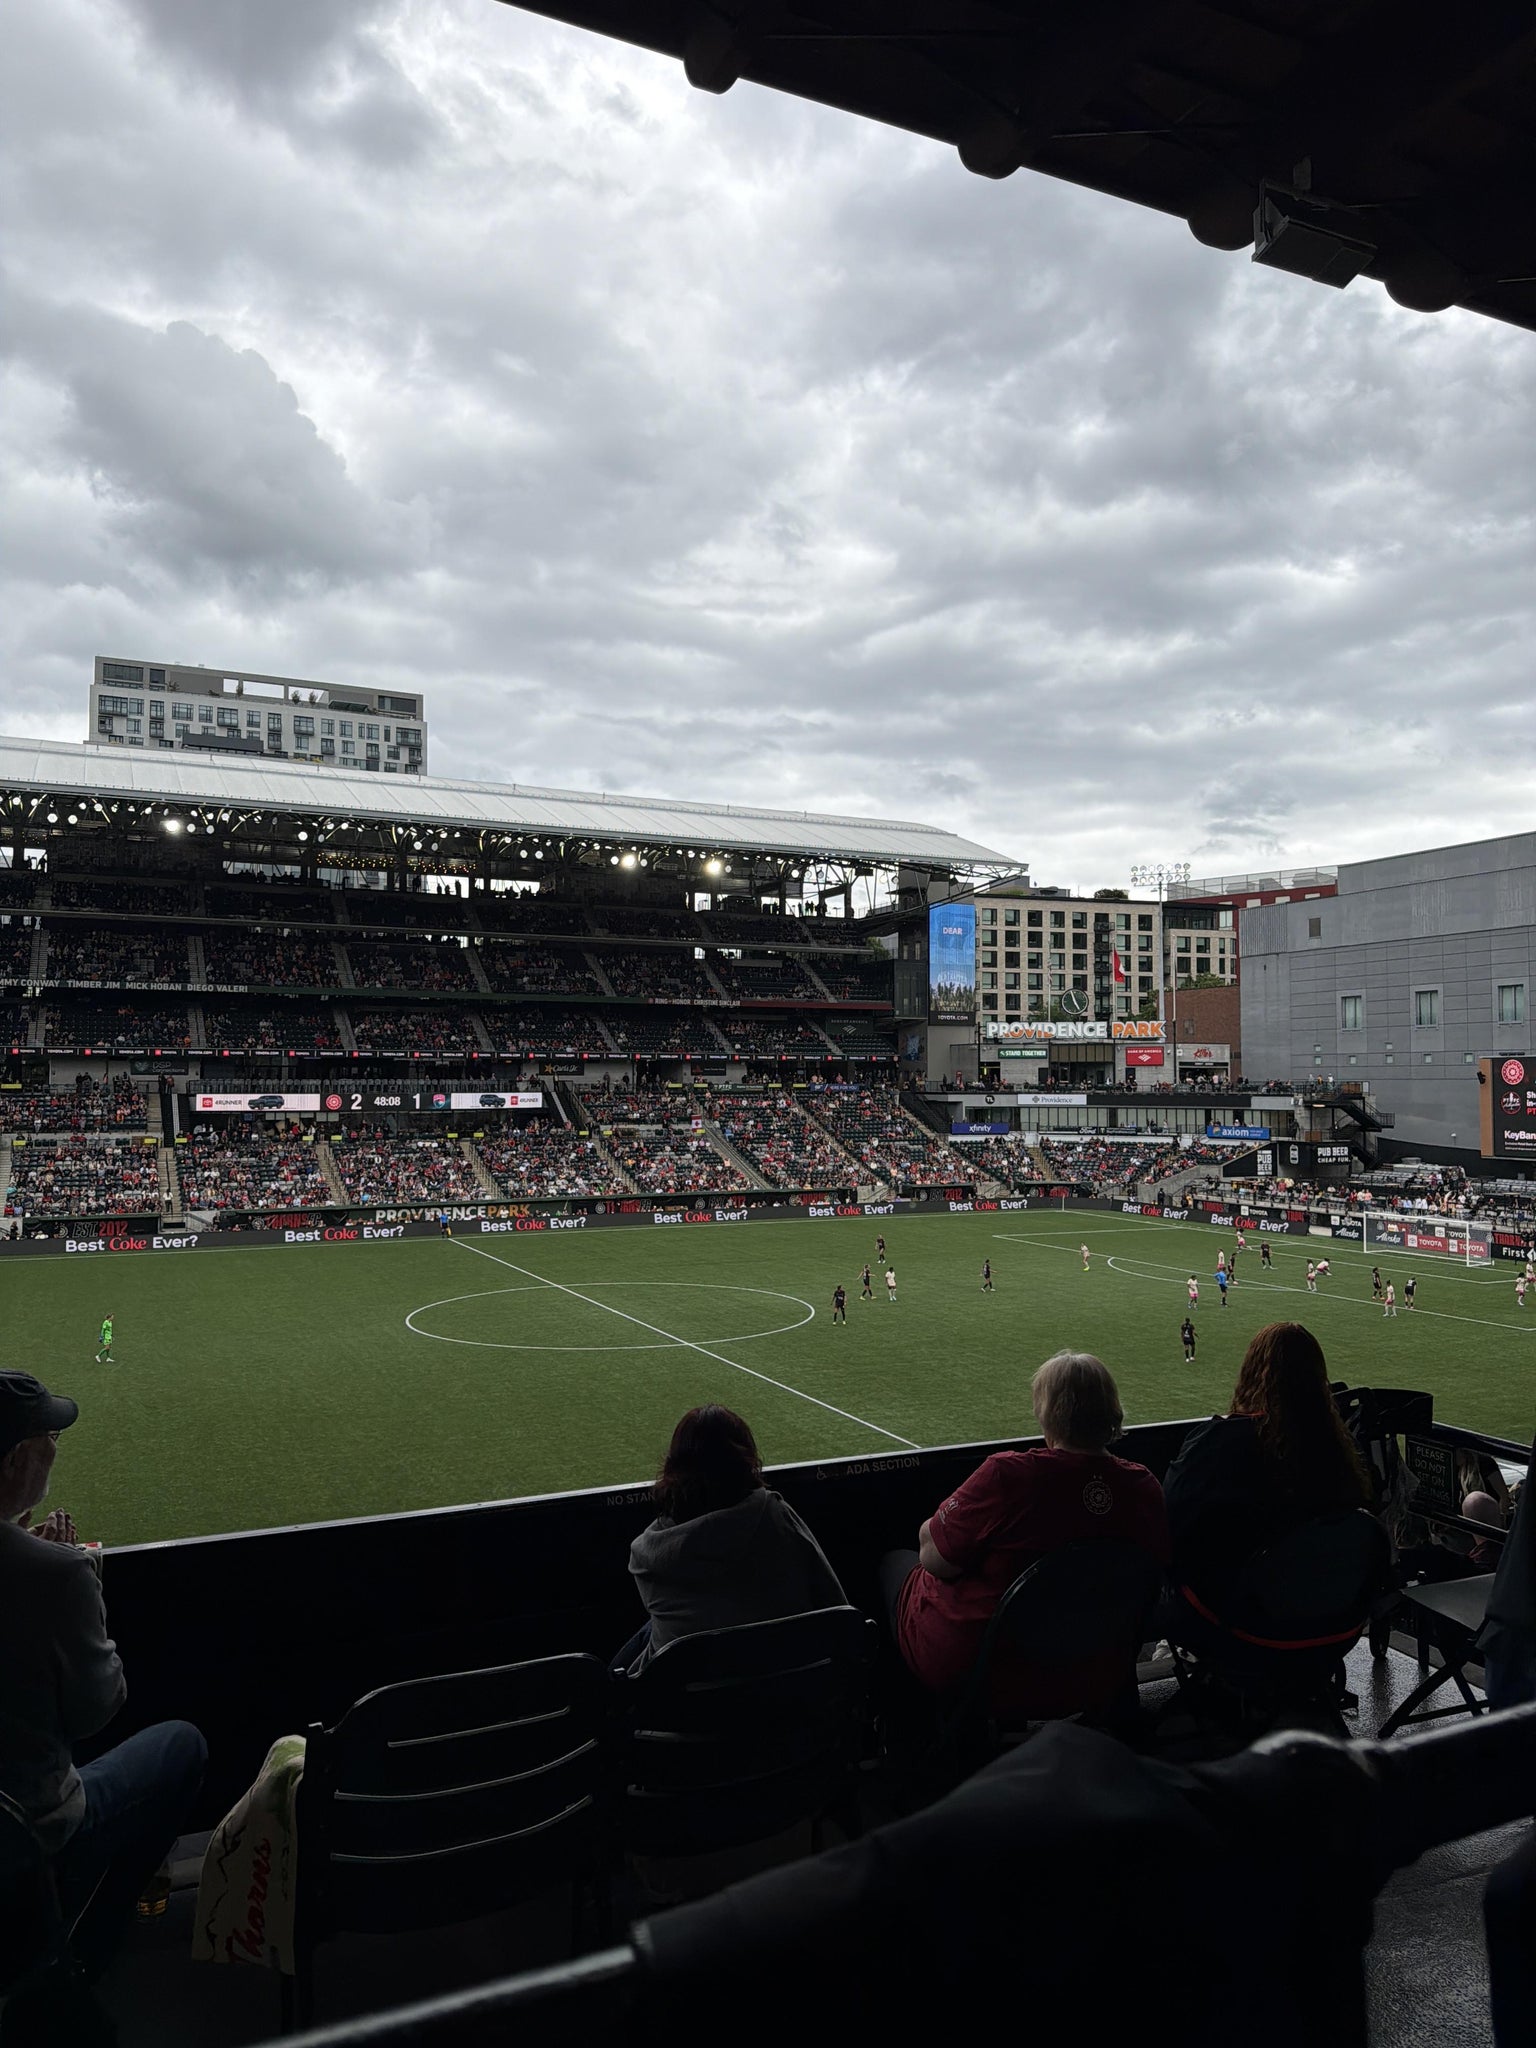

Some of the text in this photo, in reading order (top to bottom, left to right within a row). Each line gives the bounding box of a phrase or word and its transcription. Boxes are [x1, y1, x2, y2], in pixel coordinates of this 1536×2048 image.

[21, 979, 60, 987] CONWAY
[67, 980, 120, 989] TIMBER JIM
[126, 982, 182, 991] MICK HOBAN
[187, 984, 248, 993] DIEGO VALERI
[987, 1020, 1166, 1039] PROVIDENCE PARK
[351, 1093, 362, 1110] 2
[374, 1096, 401, 1106] 48:08
[412, 1093, 420, 1109] 1
[1041, 1096, 1073, 1104] Providence
[969, 1124, 992, 1133] xfinity
[1222, 1127, 1250, 1137] axiom
[1317, 1146, 1349, 1156] PUB BEER
[1257, 1155, 1273, 1164] PUB
[1257, 1164, 1273, 1172] BEER
[809, 1203, 894, 1217] Best Coke Ever?
[949, 1199, 1028, 1212] Best Coke Ever?
[1122, 1203, 1188, 1220] Best Coke Ever?
[654, 1209, 748, 1224] Best Coke Ever?
[1249, 1209, 1268, 1217] TOYOTA
[481, 1216, 586, 1232] Best Coke Ever?
[1211, 1213, 1289, 1233] Best Coke Ever?
[72, 1220, 129, 1239] EST. 2012
[285, 1225, 404, 1242] Best Coke Ever?
[1335, 1227, 1360, 1239] Alaska
[1376, 1232, 1401, 1243] Alaska
[1418, 1238, 1443, 1248] TOYOTA
[66, 1235, 198, 1253] Best Coke Ever?
[1459, 1243, 1485, 1253] TOYOTA
[1502, 1247, 1525, 1258] First
[1416, 1446, 1446, 1462] PLEASE
[846, 1455, 920, 1476] ADA SECTION
[1415, 1459, 1446, 1477] DO NOT
[607, 1495, 624, 1507] NO
[226, 1838, 272, 1964] Thorns
